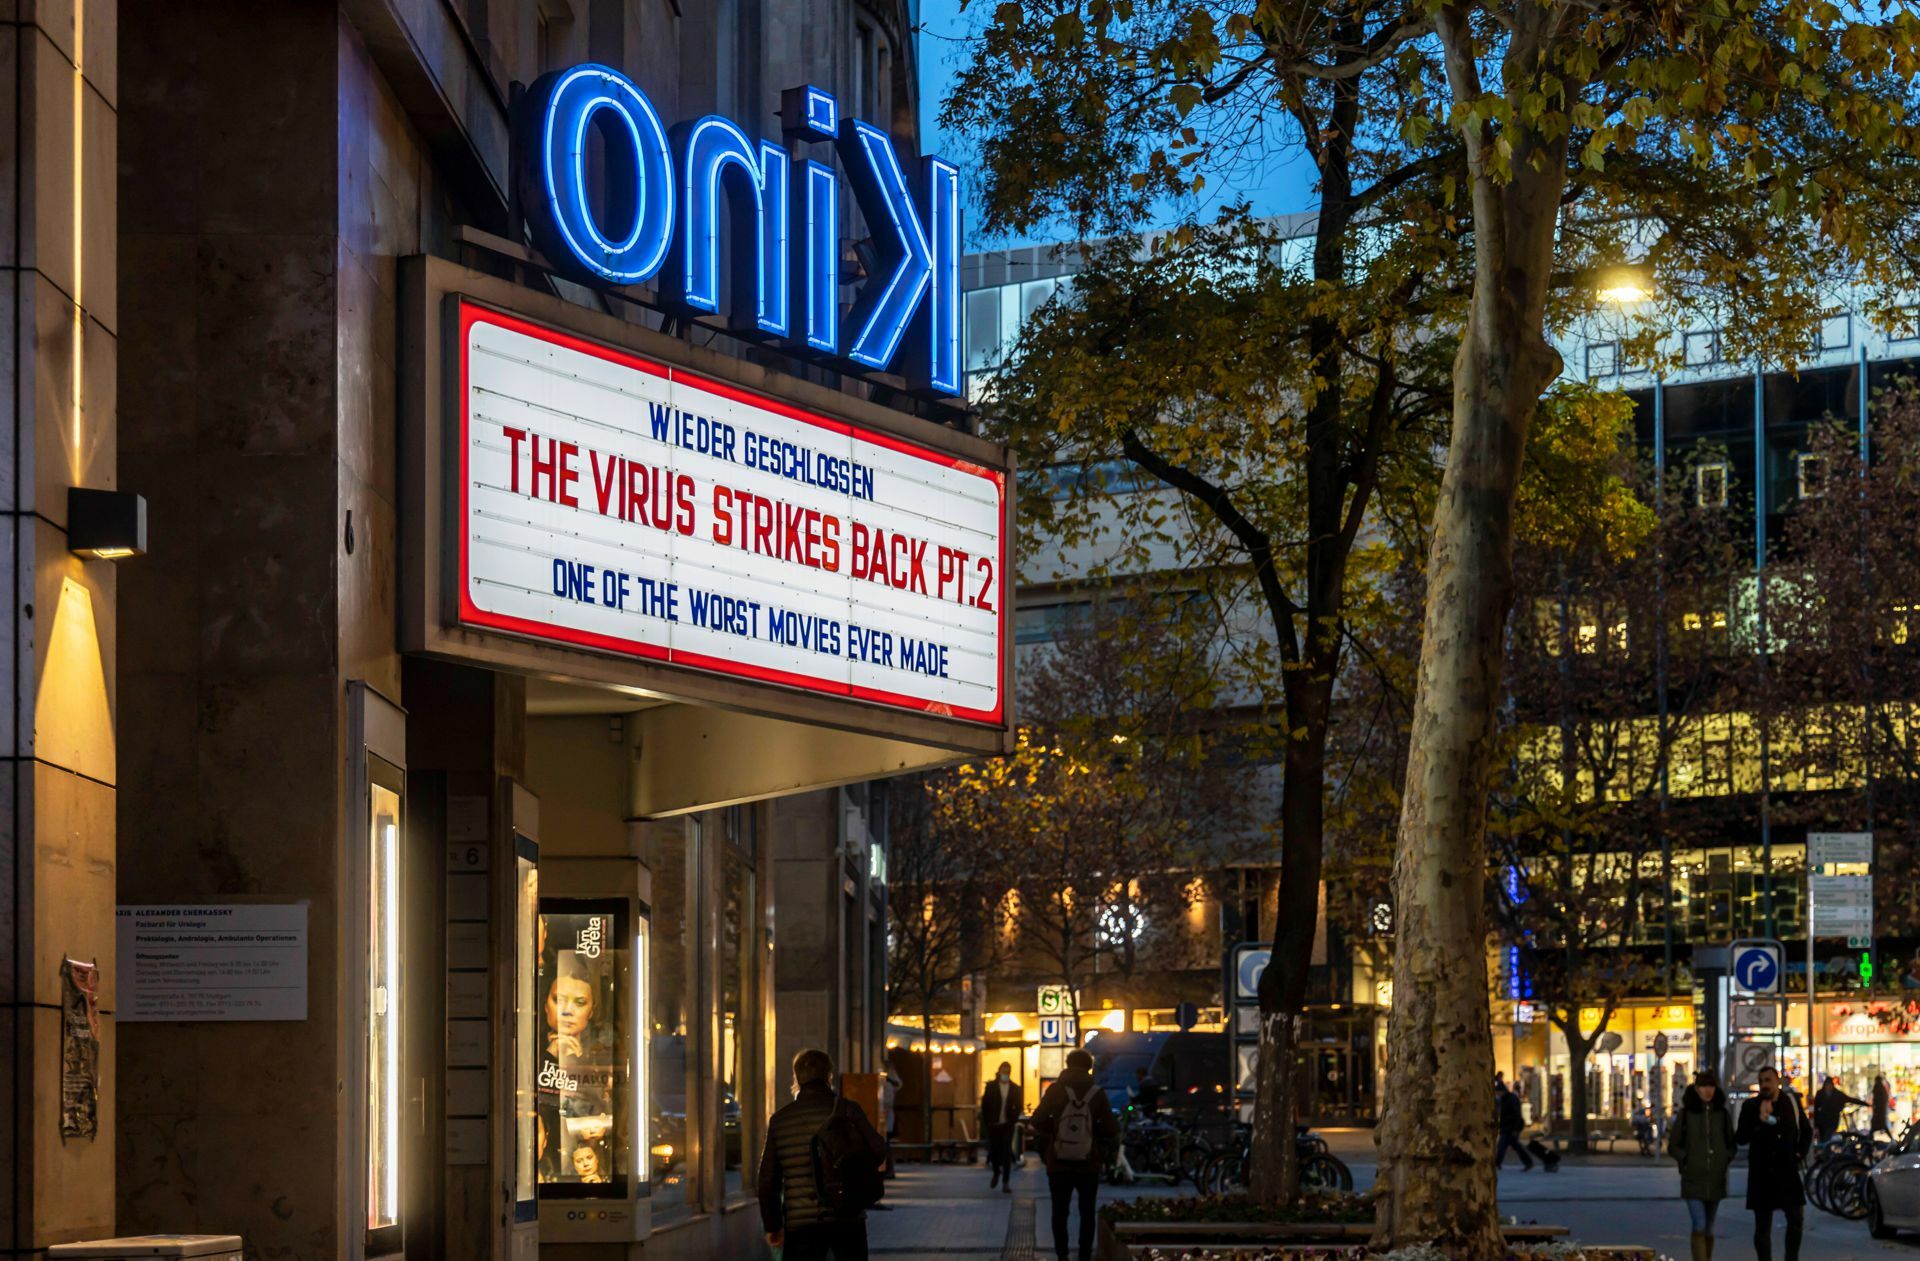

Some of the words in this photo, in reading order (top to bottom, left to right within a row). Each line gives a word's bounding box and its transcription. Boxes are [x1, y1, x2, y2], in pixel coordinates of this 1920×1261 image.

[648, 402, 736, 463] WIEDER
[744, 431, 874, 500] GESCHLOSSEN
[503, 427, 579, 508] THE
[589, 449, 696, 537] VIRUS
[712, 485, 841, 573] STRIKES
[851, 522, 928, 595] BACK
[937, 546, 993, 612] PT.2
[552, 558, 595, 605] ONE
[602, 569, 630, 609] OF
[638, 577, 679, 621] THE
[688, 589, 761, 639] WORST
[768, 607, 841, 657] MOVIES
[847, 625, 893, 667] EVER
[900, 639, 949, 678] MADE
[135, 909, 181, 917] ALEXANDER
[182, 909, 233, 917] CHERKASSKY
[586, 916, 601, 959] Greta
[1044, 1020, 1058, 1038] U
[1830, 1020, 1885, 1038] Europa
[538, 1072, 578, 1091] Greta
